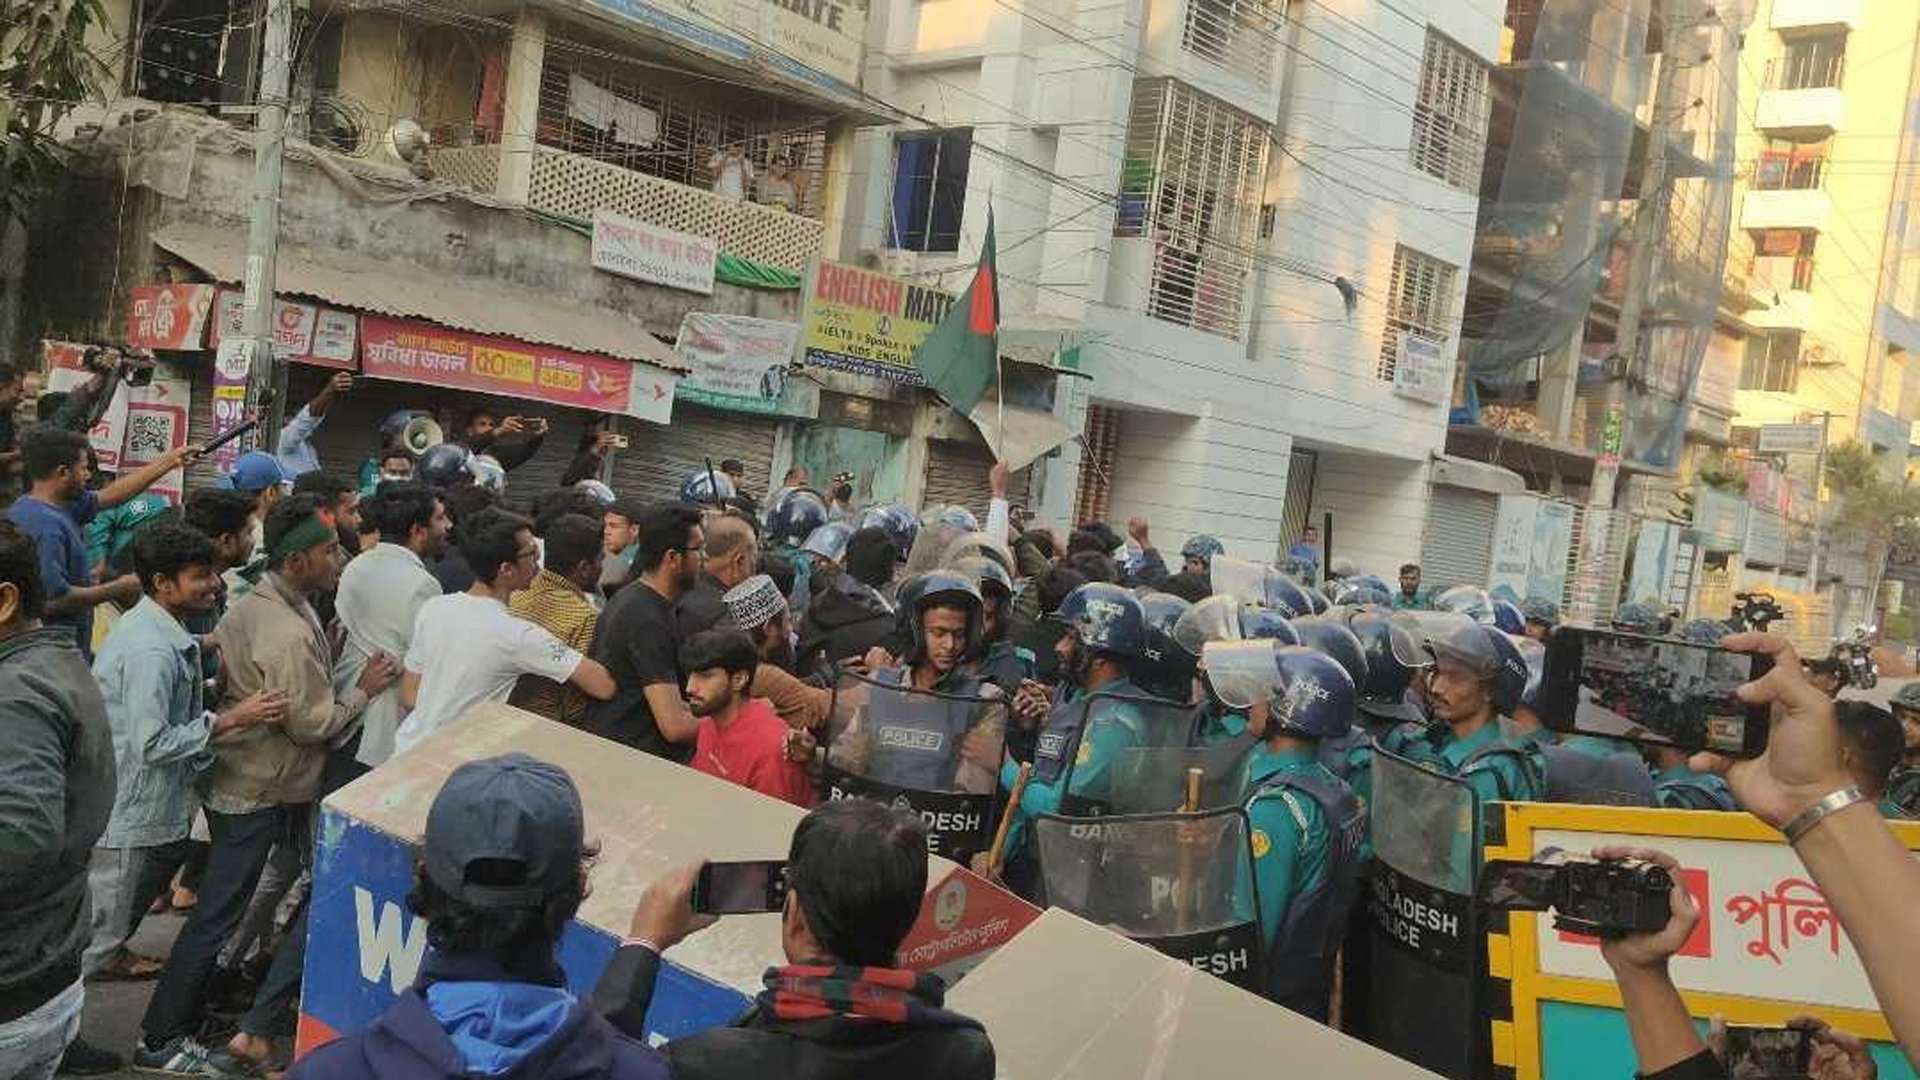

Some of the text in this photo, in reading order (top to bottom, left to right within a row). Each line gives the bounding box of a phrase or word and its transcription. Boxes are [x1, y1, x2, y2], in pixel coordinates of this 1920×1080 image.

[816, 260, 903, 318] ENGLISH
[366, 339, 416, 366] সুবিধা
[875, 350, 912, 366] ENGLI
[882, 731, 937, 747] POLICE
[1725, 878, 1842, 966] পুলি
